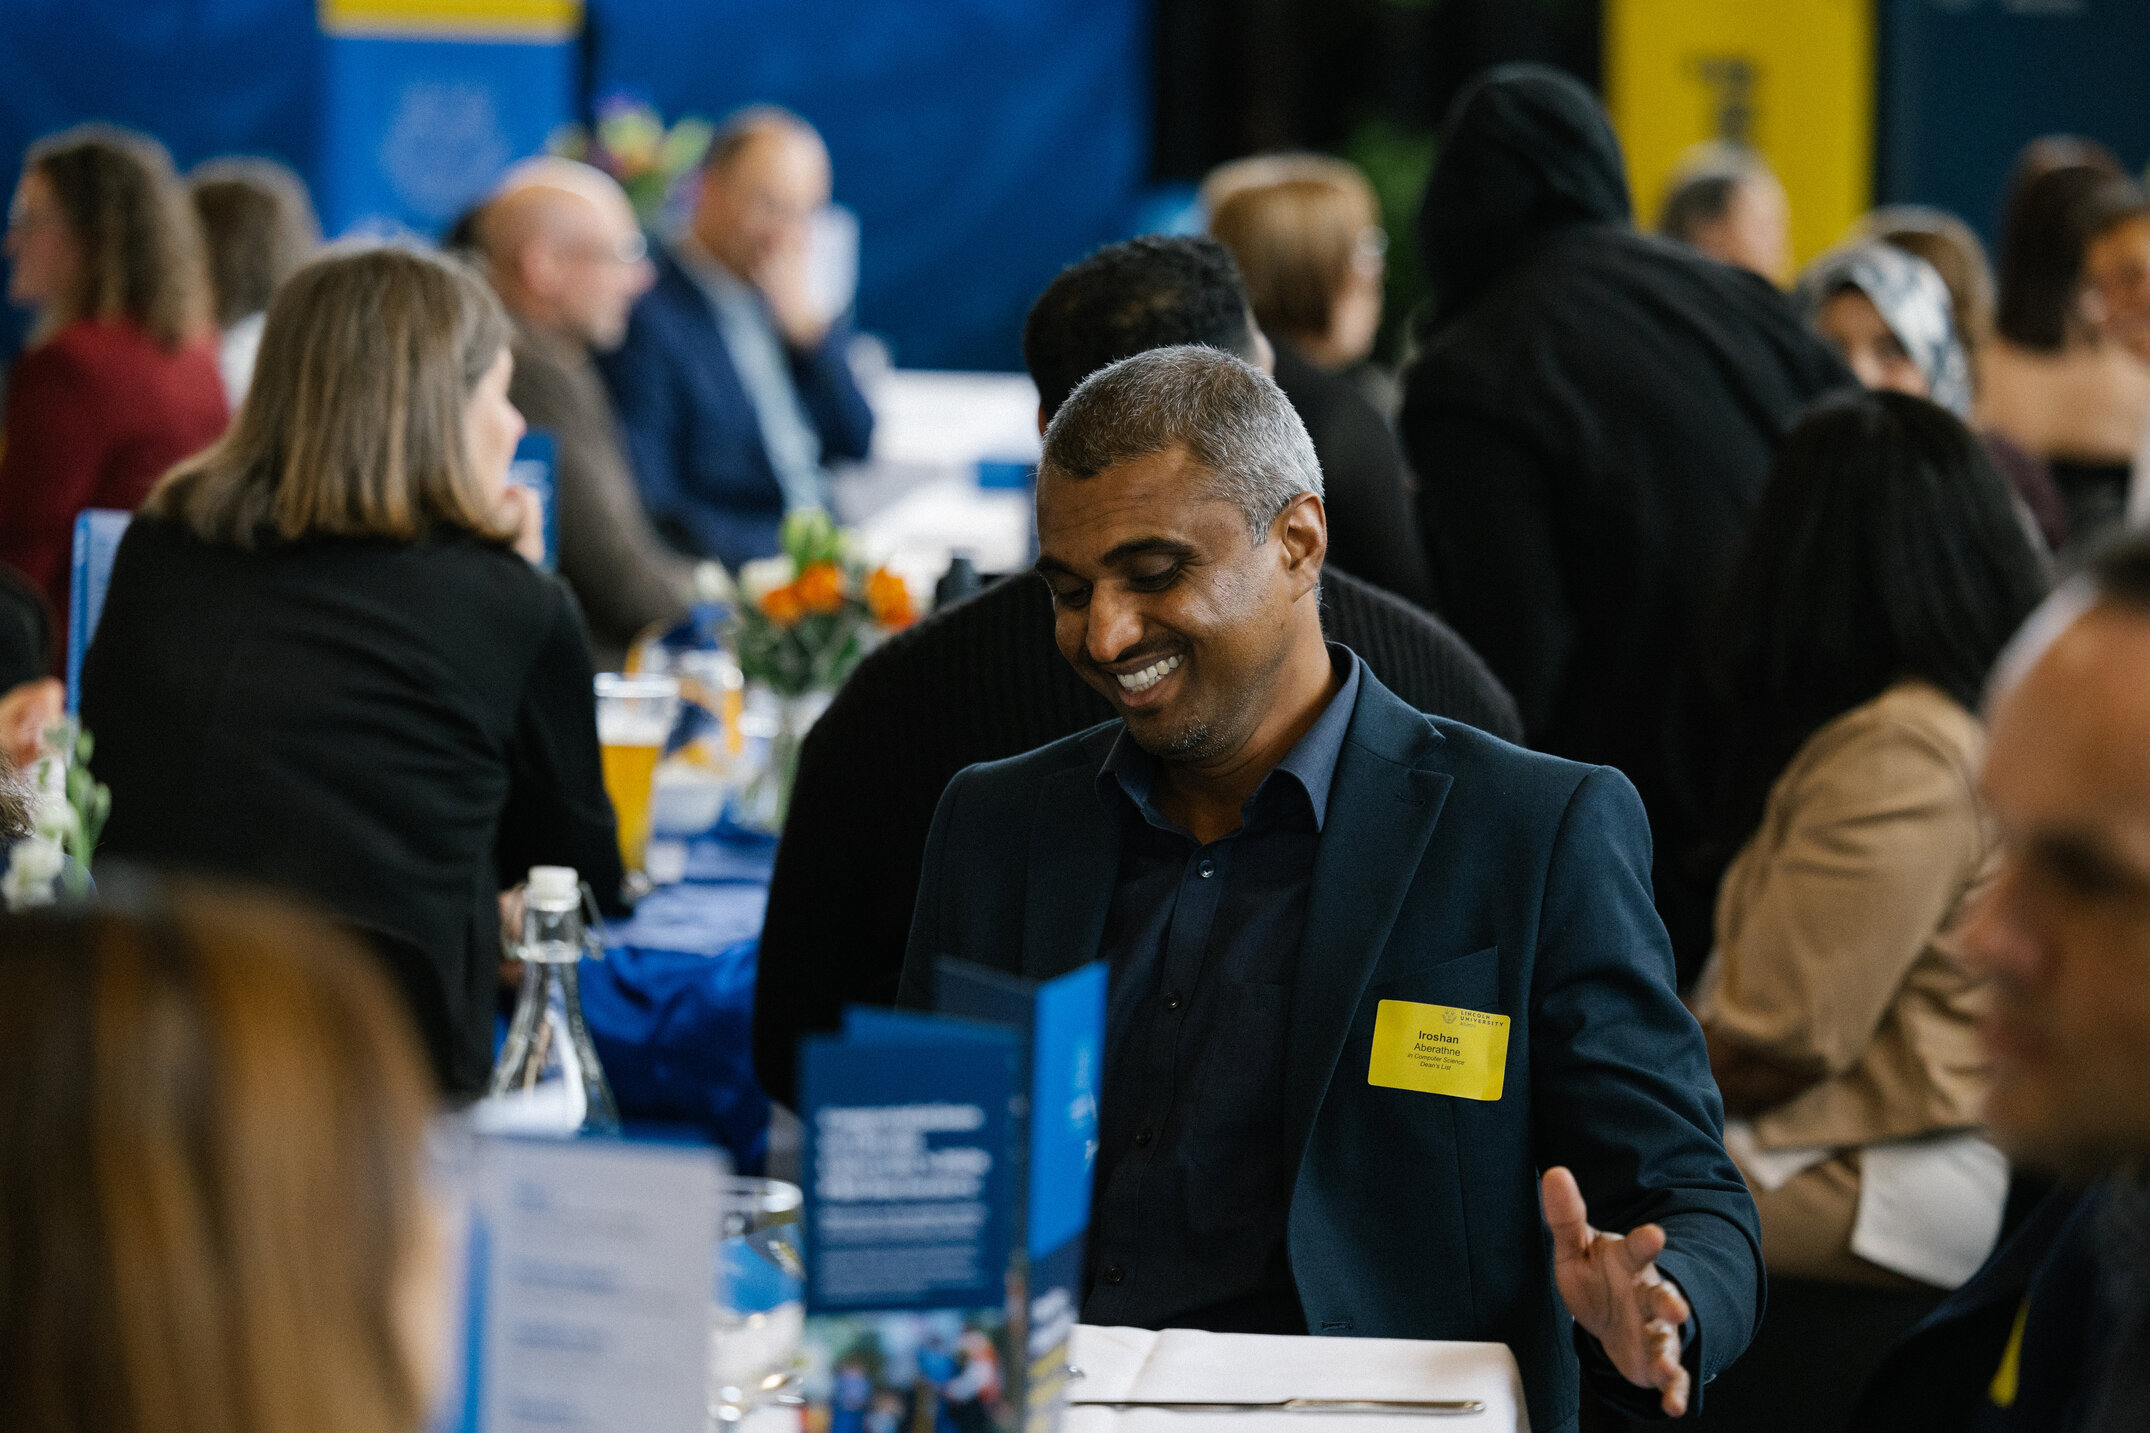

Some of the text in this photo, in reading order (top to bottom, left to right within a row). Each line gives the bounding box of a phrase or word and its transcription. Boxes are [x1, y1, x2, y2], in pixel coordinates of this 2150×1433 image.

[1460, 1010, 1490, 1019] LINCOLN
[1460, 1016, 1504, 1026] UNIVERSITY
[1418, 1030, 1459, 1044] Iroshan
[1413, 1042, 1461, 1056] Aberathne
[1414, 1053, 1442, 1062] Computer
[1443, 1056, 1465, 1065] Science
[1420, 1061, 1440, 1069] Dean's
